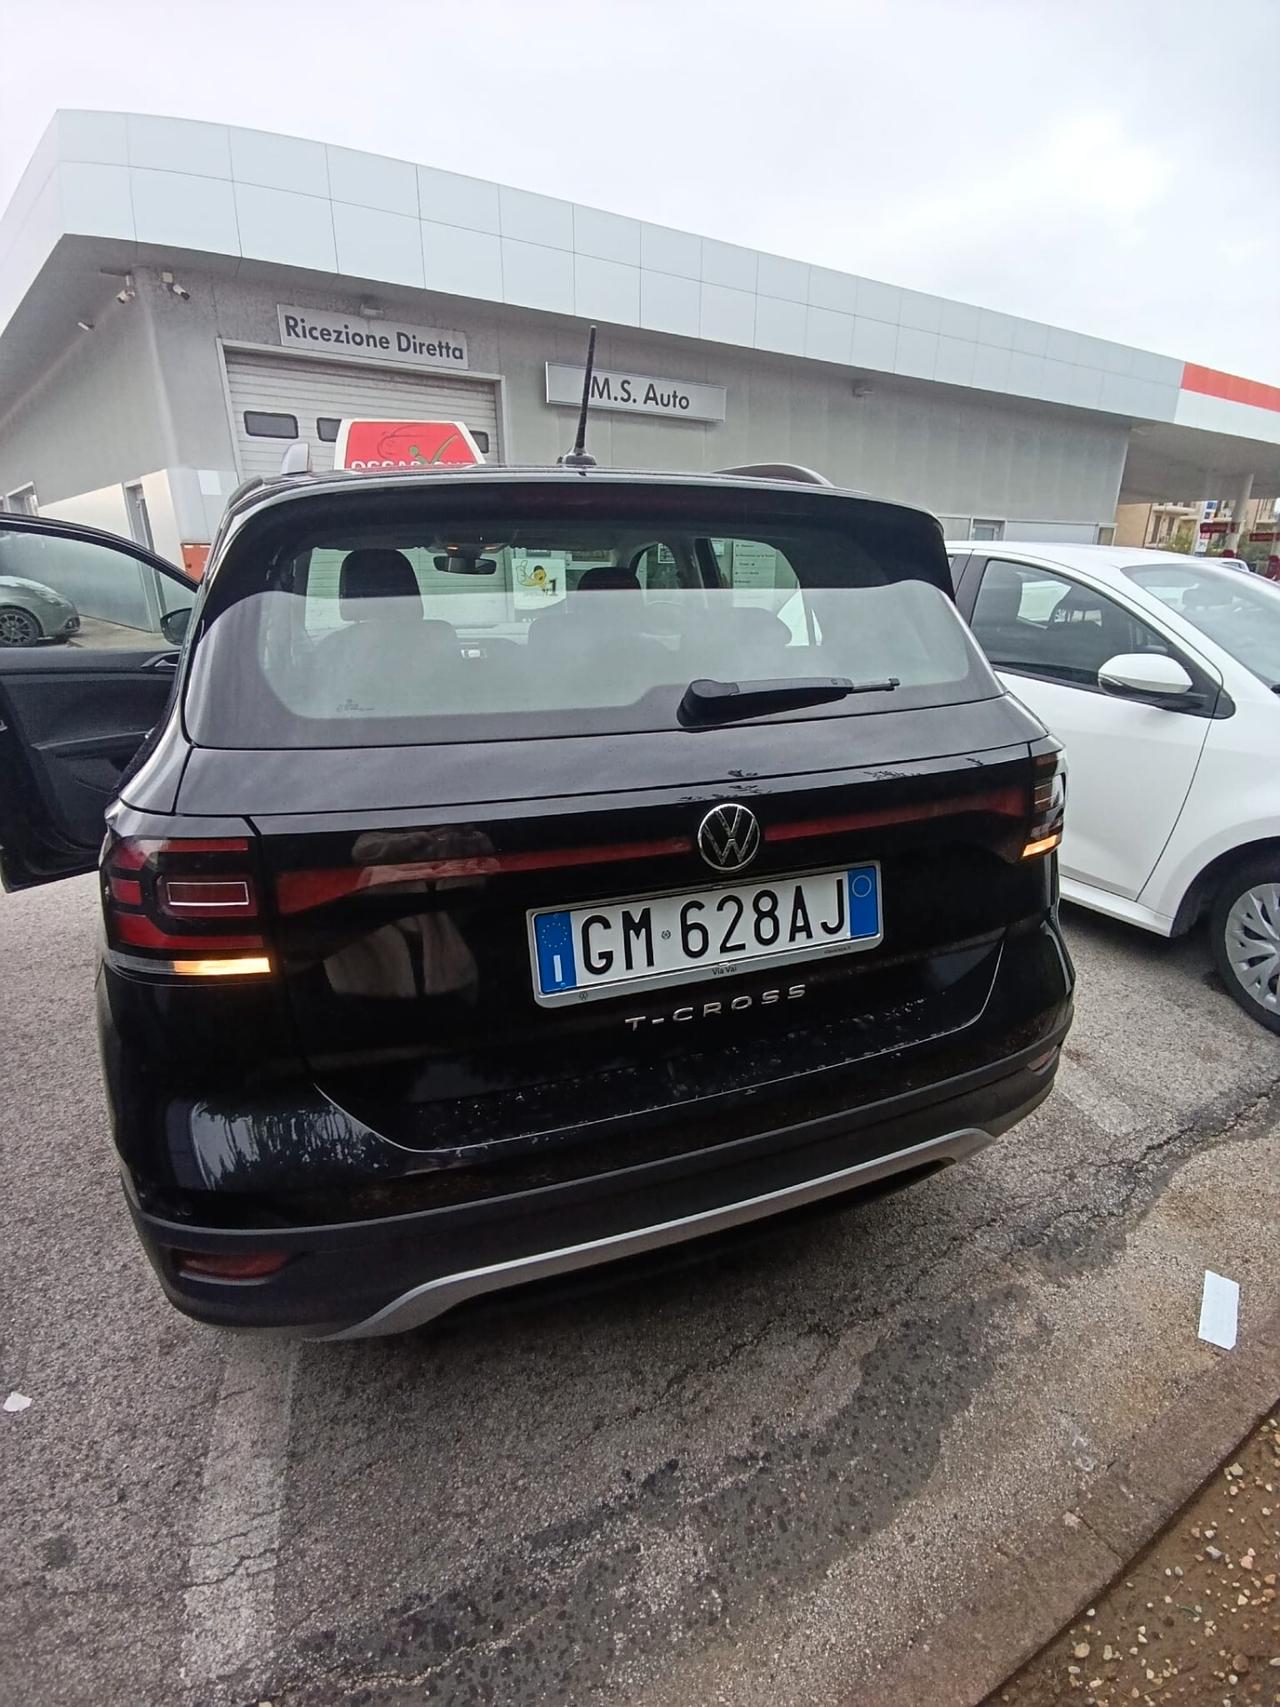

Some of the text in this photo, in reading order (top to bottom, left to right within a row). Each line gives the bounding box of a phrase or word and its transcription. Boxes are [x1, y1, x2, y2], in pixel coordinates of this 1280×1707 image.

[284, 315, 464, 360] Ricezione Diretta
[590, 375, 690, 410] M.S. Auto
[580, 878, 846, 976] GM 628AJ
[624, 983, 807, 1032] T-CROSS
